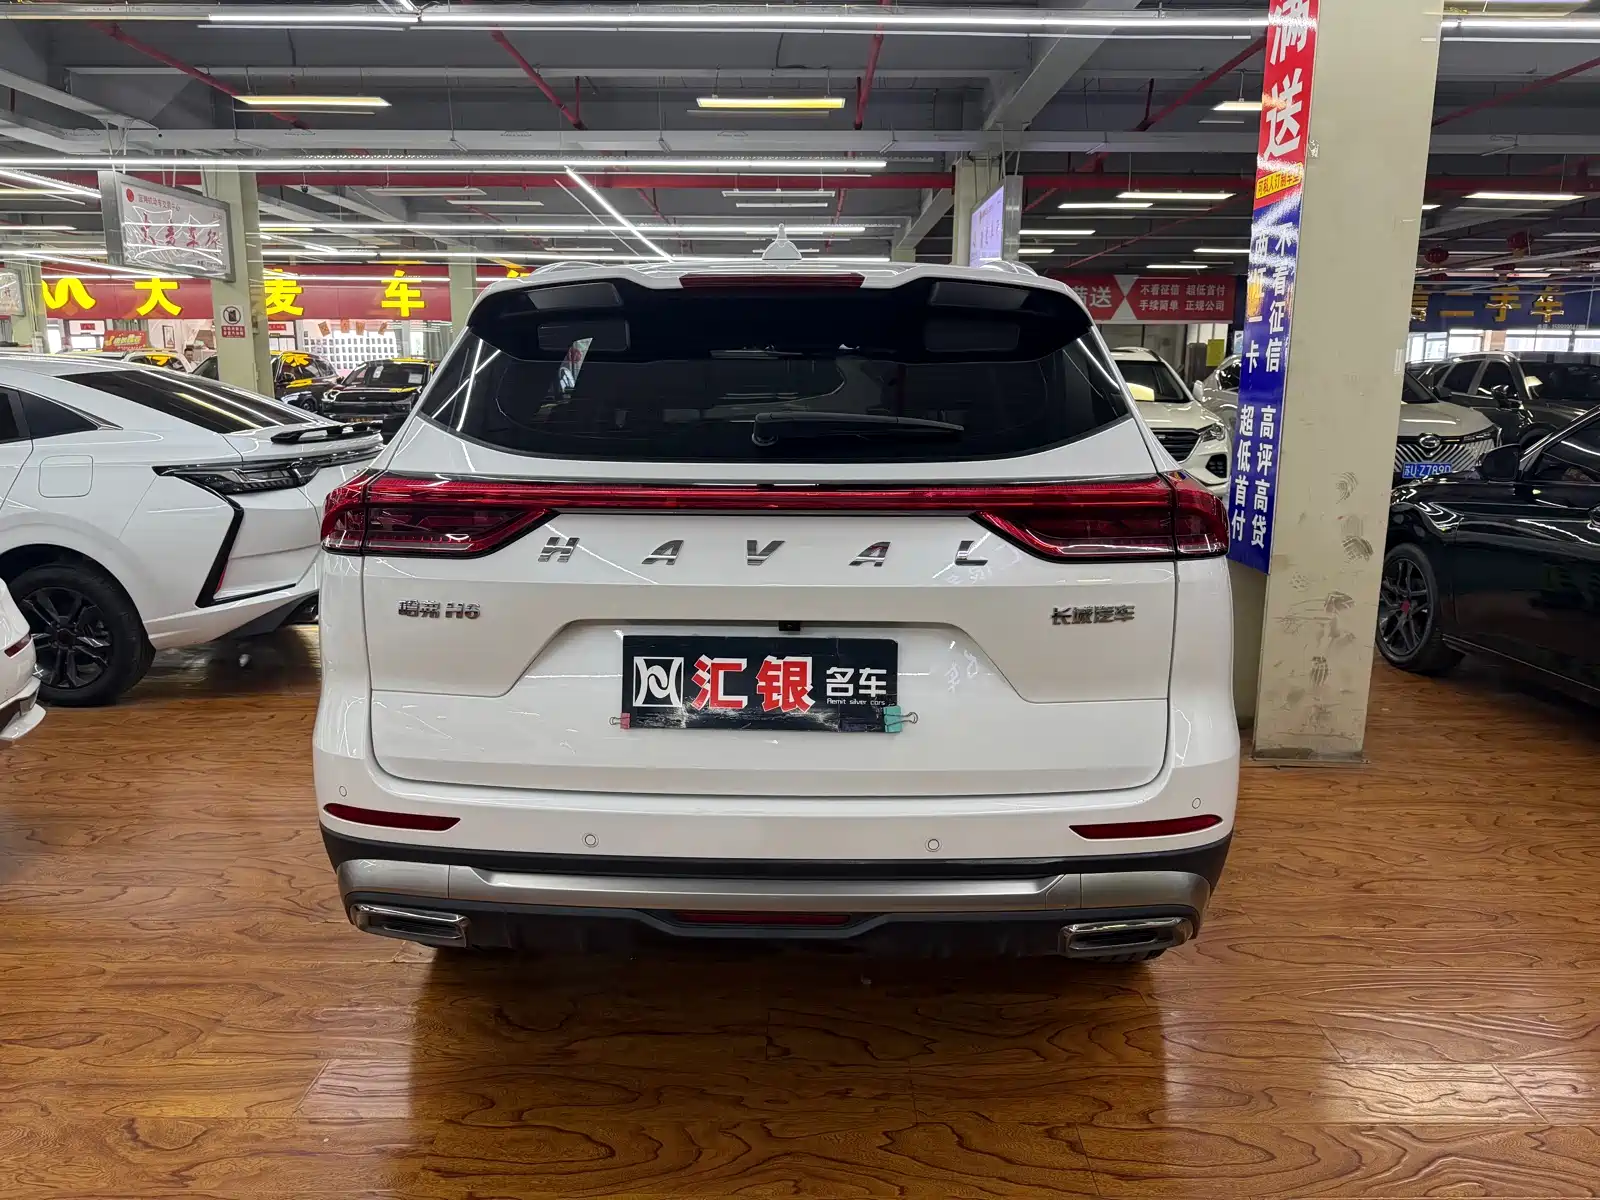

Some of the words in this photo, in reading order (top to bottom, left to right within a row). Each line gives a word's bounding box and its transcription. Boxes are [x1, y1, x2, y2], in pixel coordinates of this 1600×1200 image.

[1140, 300, 1179, 311] 手续简单
[1185, 300, 1224, 311] 正规公司
[1141, 284, 1180, 296] 不看征信
[1186, 284, 1225, 297] 超低首付
[1265, 222, 1293, 372] 不看征信
[1231, 404, 1254, 541] 超低首付
[1251, 405, 1276, 548] 高评高贷
[537, 537, 989, 567] HAVAL
[445, 602, 481, 619] H6
[1051, 604, 1135, 625] 长城汽车
[691, 654, 816, 713] 汇银
[826, 667, 887, 698] 名车
